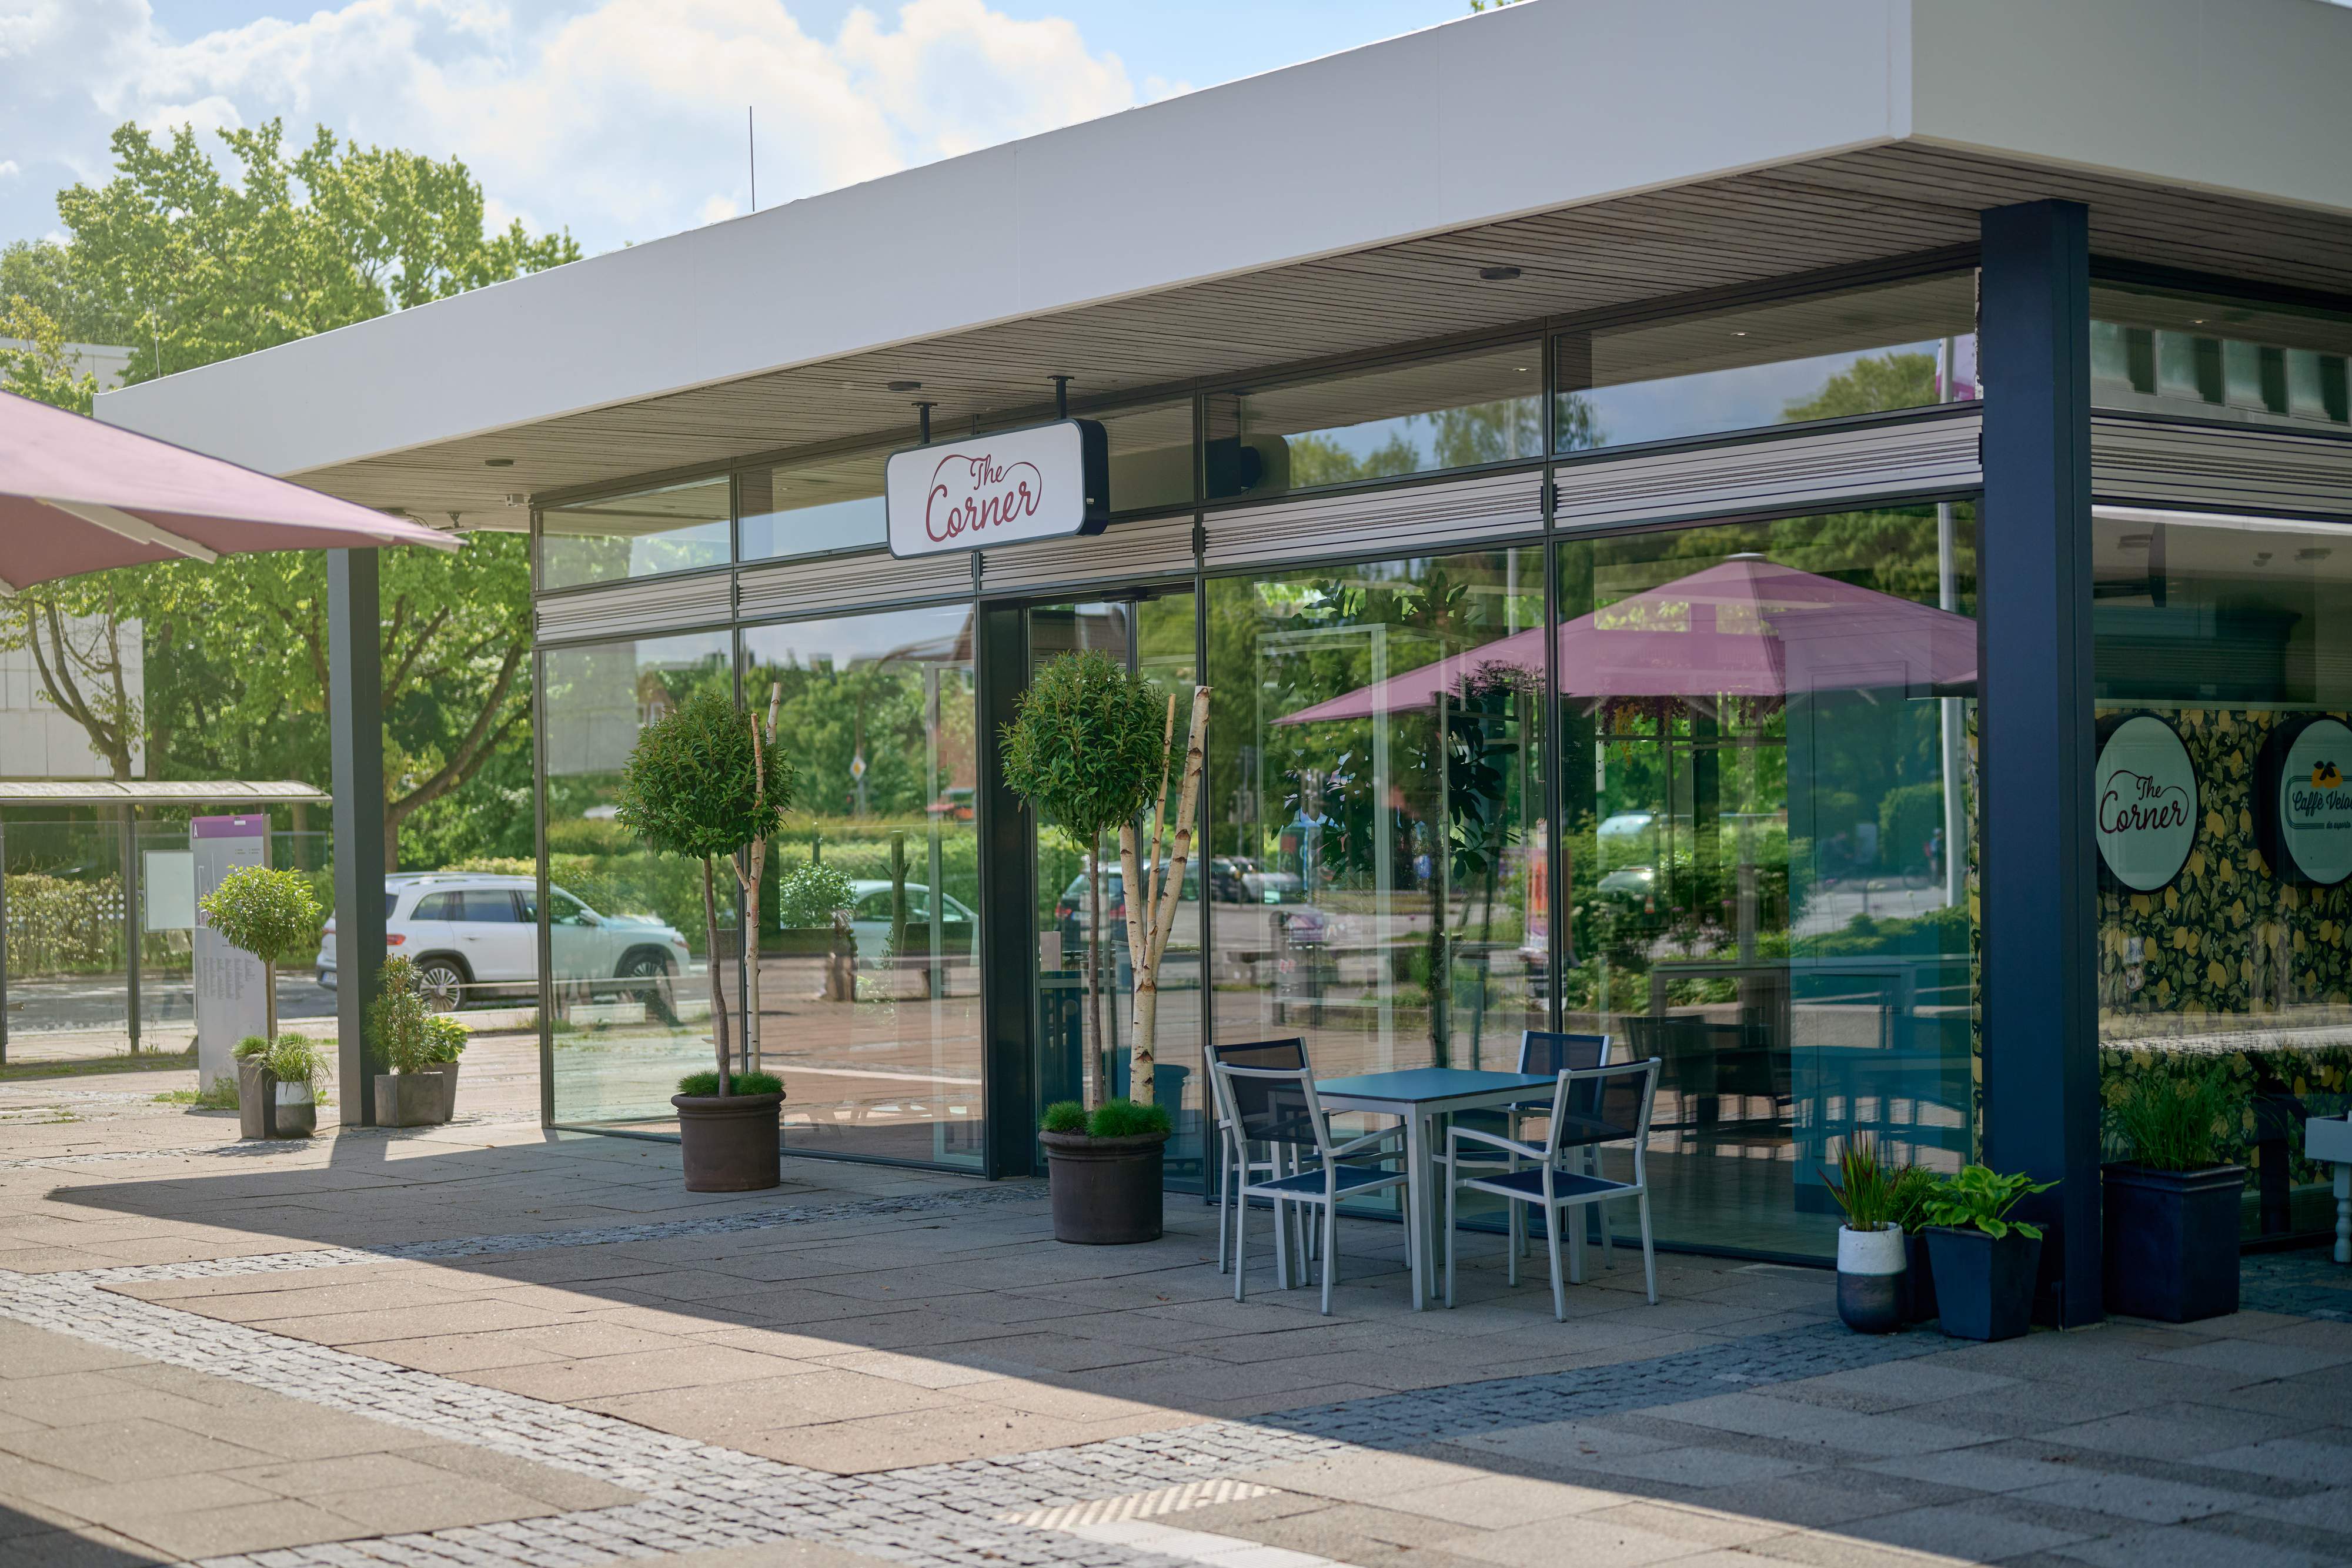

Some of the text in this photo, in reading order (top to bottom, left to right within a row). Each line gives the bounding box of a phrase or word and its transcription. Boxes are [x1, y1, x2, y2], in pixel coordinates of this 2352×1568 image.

[970, 454, 1003, 490] The
[926, 480, 1041, 543] Corner
[2136, 775, 2162, 800] The
[2292, 790, 2324, 817] Caffè
[2099, 790, 2188, 834] Corner
